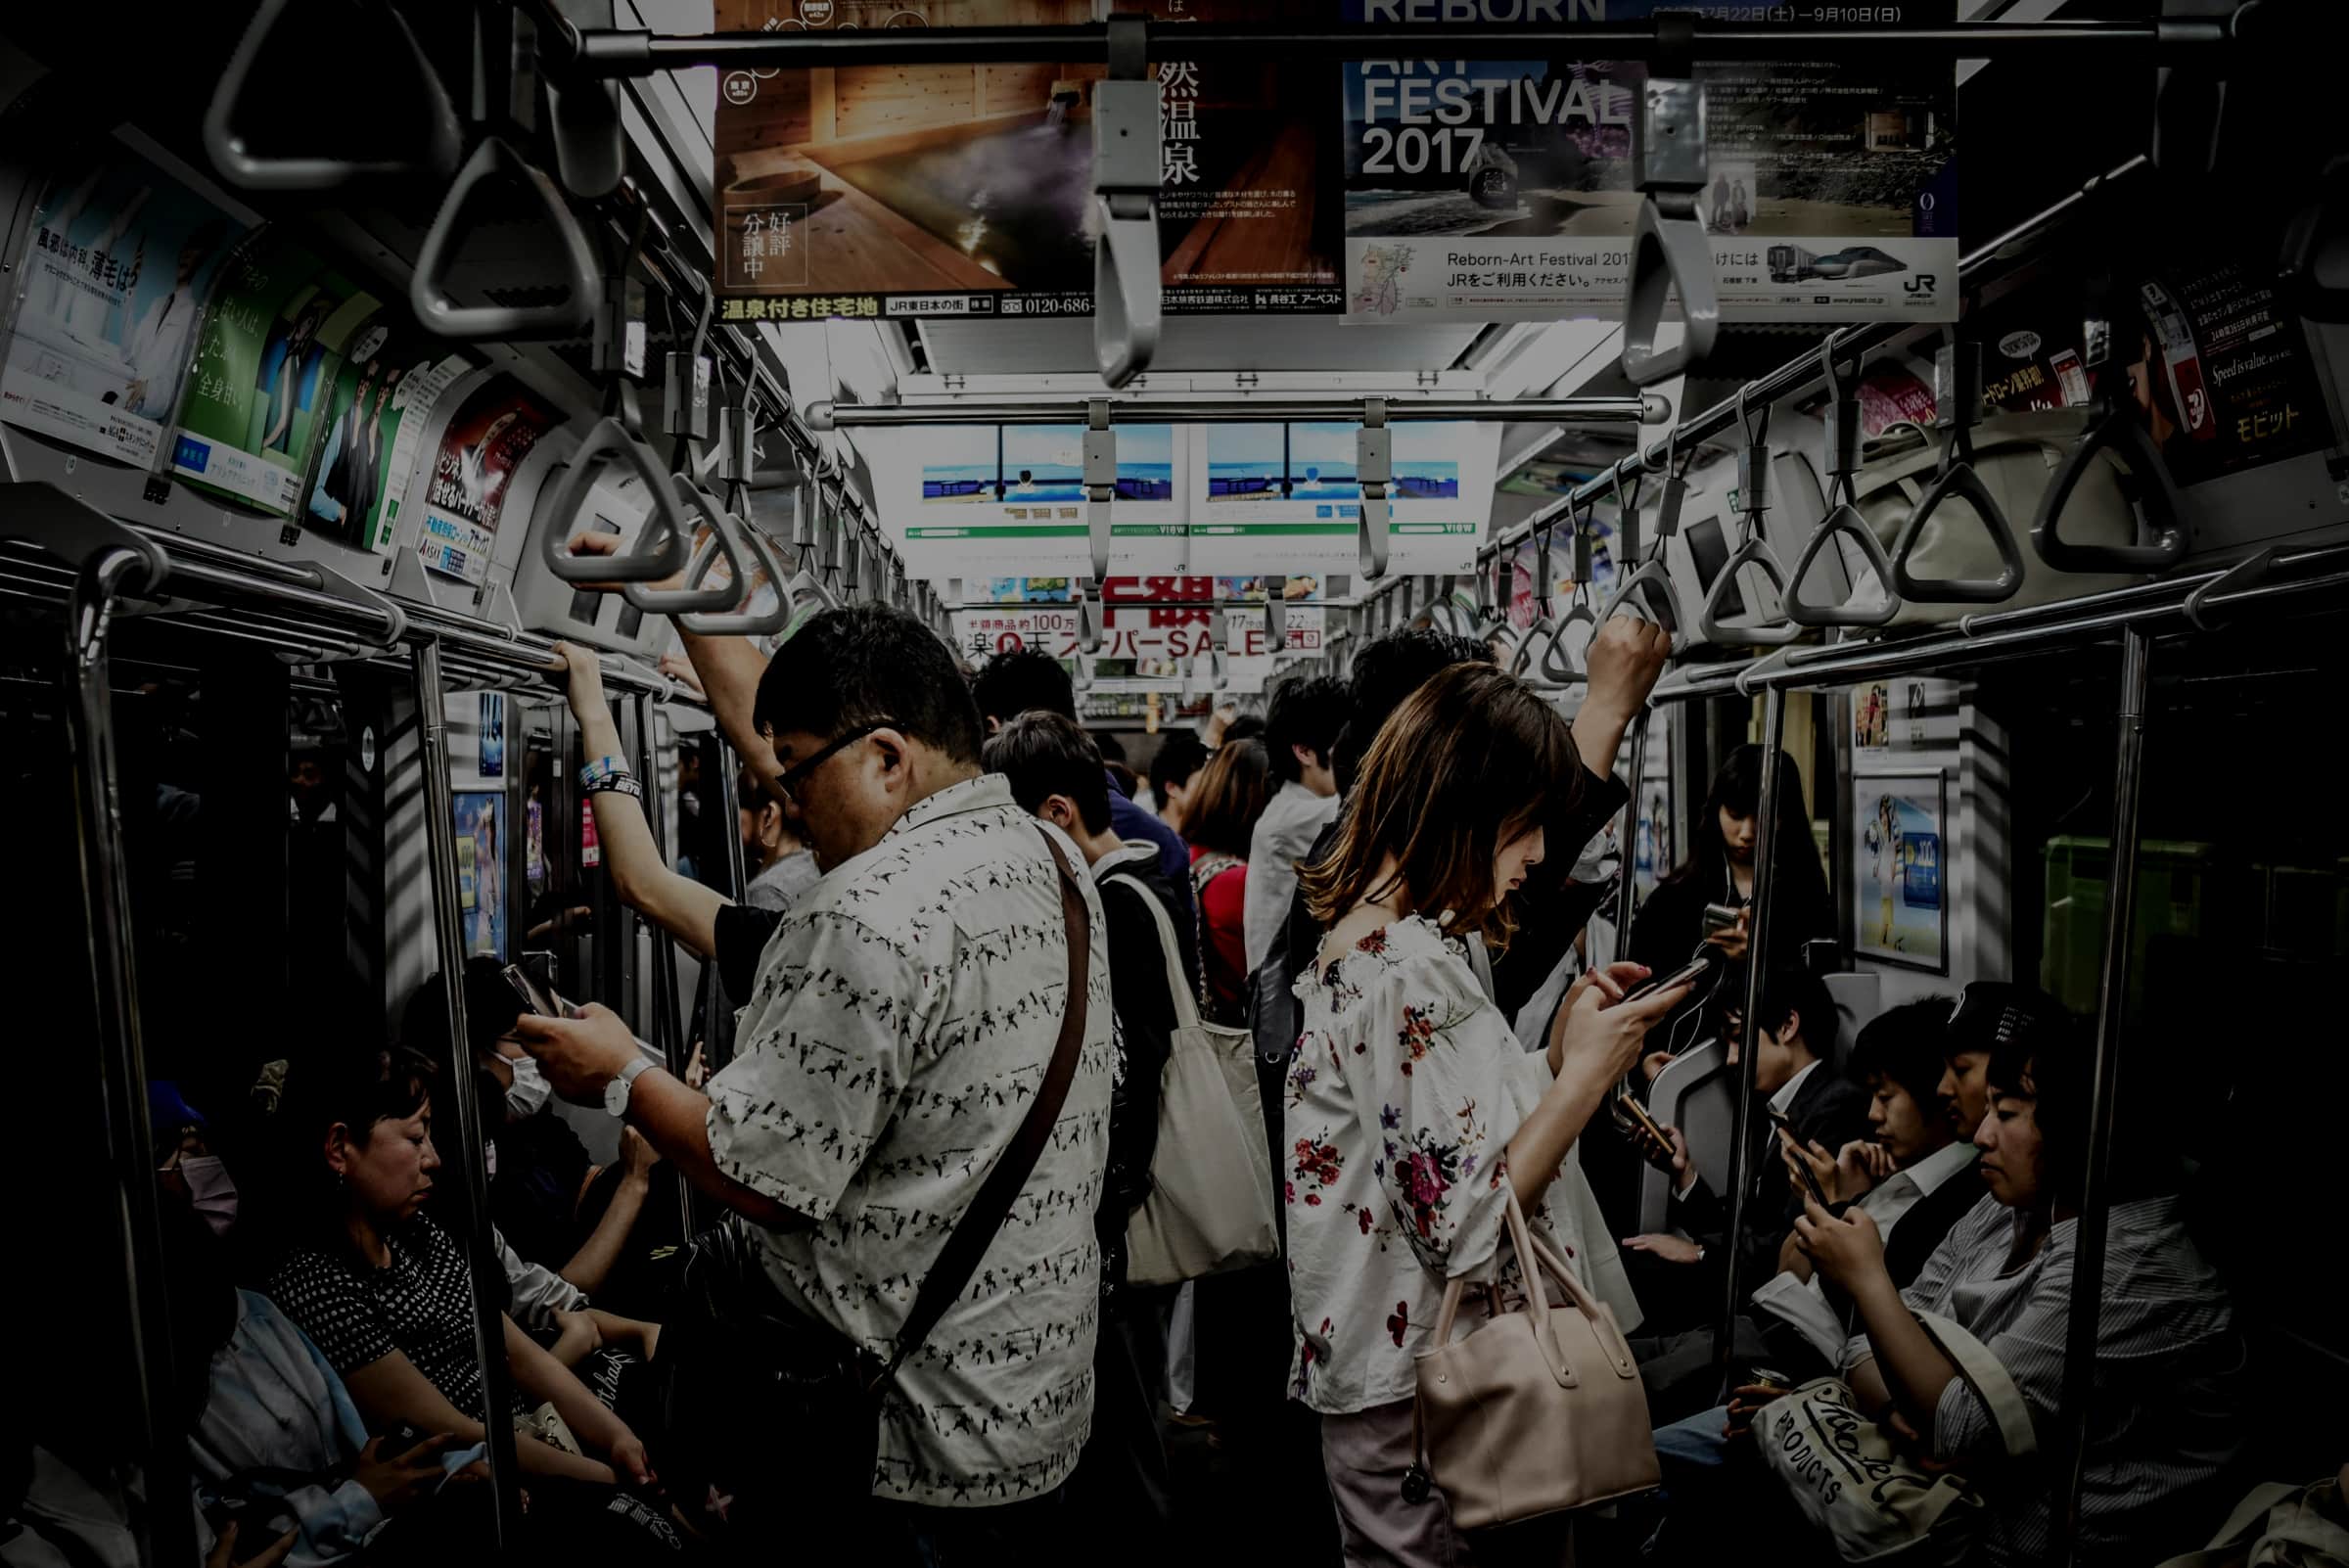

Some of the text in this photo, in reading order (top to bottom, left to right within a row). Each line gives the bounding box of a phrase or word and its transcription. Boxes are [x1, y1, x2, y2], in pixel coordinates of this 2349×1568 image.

[1363, 77, 1630, 125] FESTIVAL
[1361, 126, 1486, 174] 2017
[743, 213, 764, 280] 分譲中
[768, 210, 792, 257] 好評
[1448, 253, 1633, 266] Reborn-Art Festival 201
[1716, 253, 1760, 266] けには
[1447, 272, 1589, 288] JRをご利用ください。
[1904, 274, 1936, 293] JR
[720, 297, 878, 320] 温泉付き住宅地
[890, 300, 963, 312] JR東日本の街
[2212, 358, 2237, 389] Speed
[2236, 402, 2300, 442] モビット
[1774, 1409, 1842, 1505] PRODUCTS
